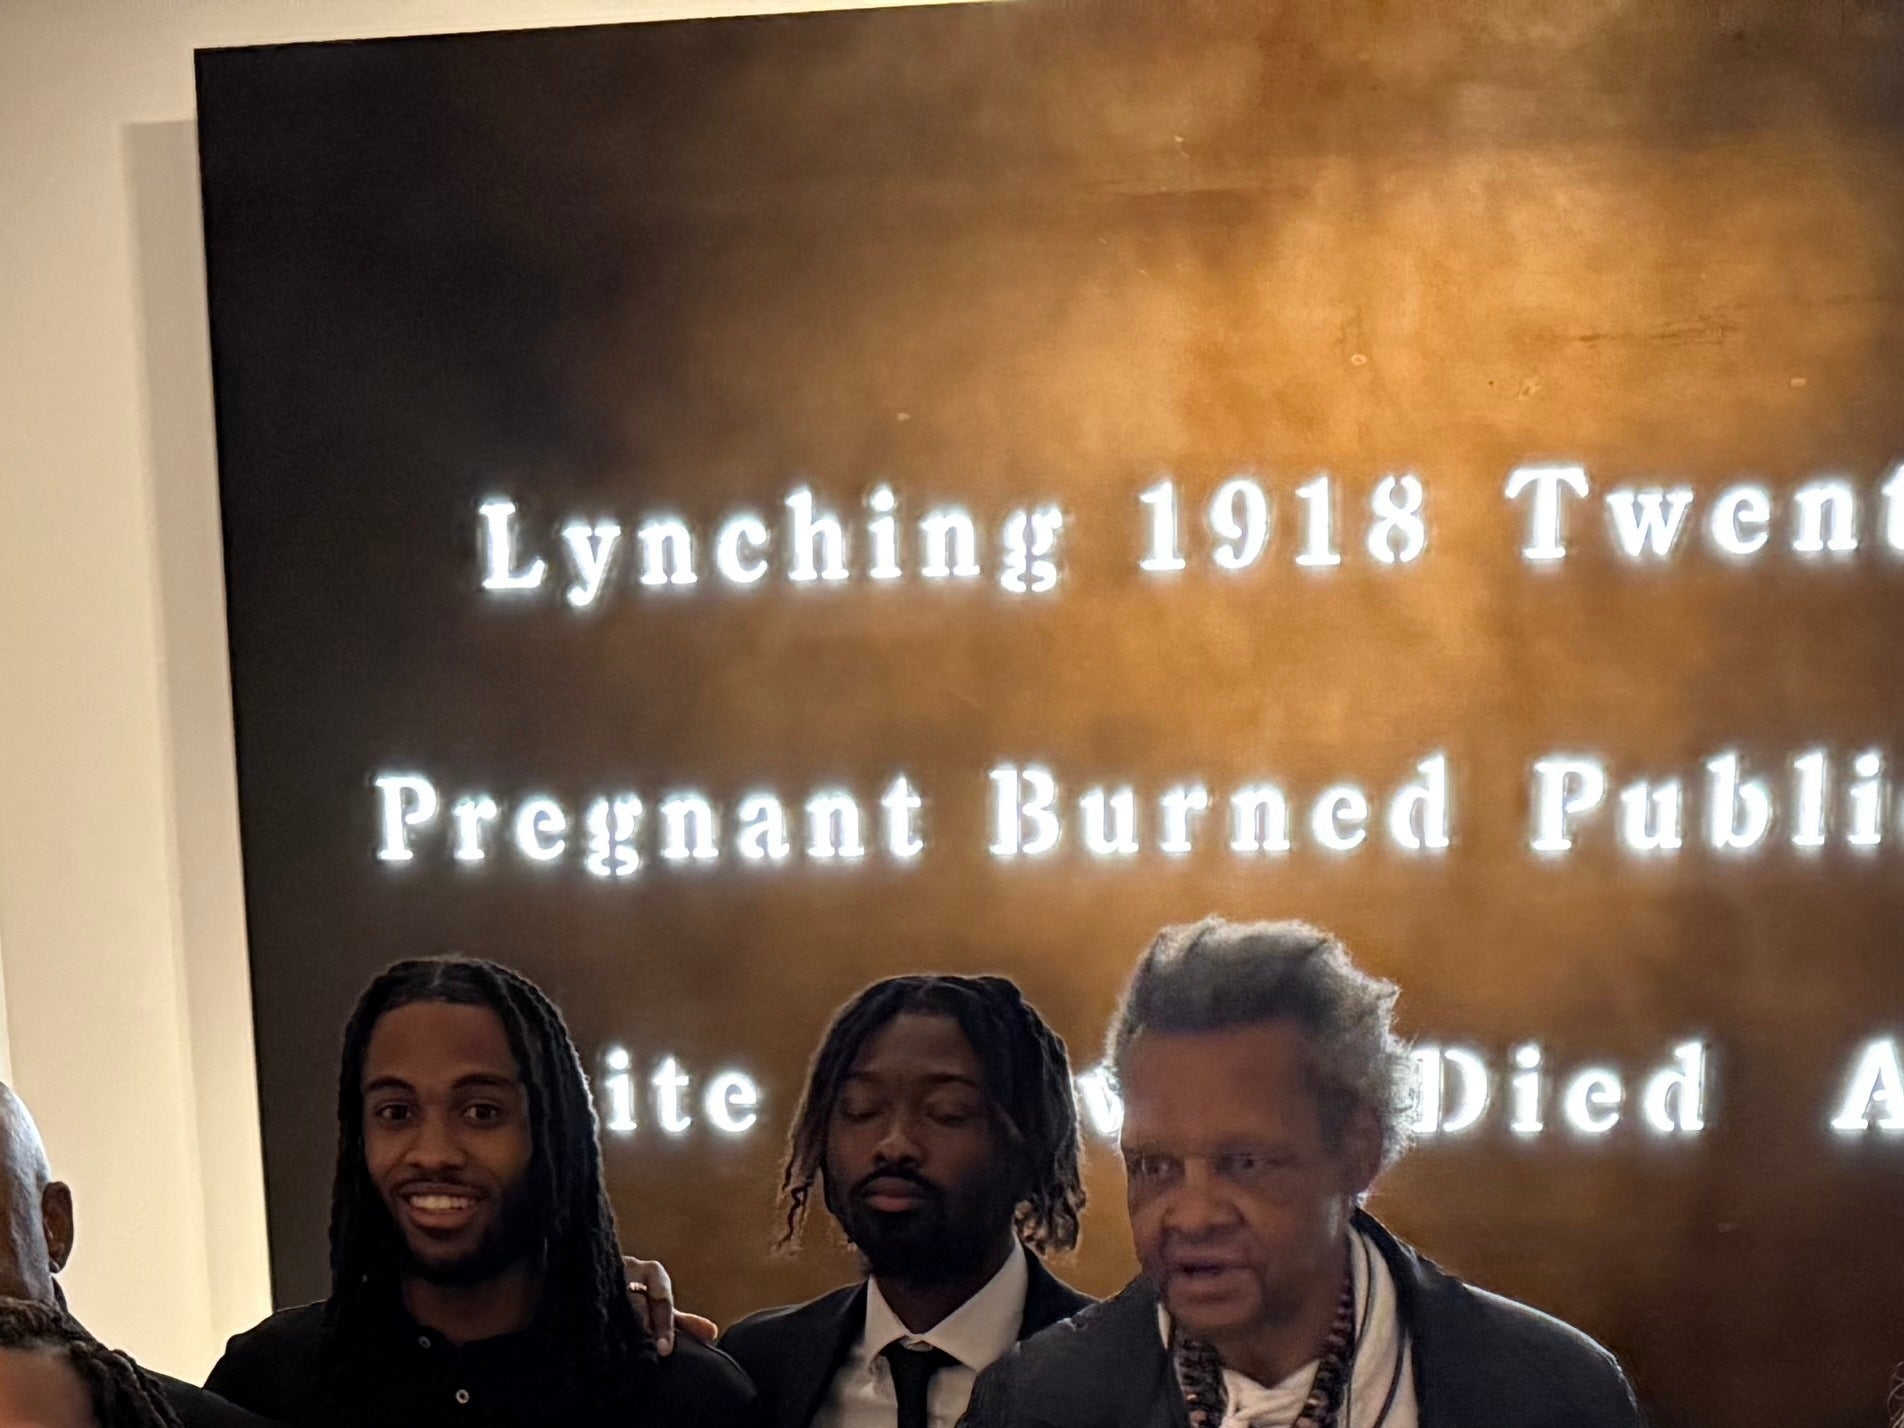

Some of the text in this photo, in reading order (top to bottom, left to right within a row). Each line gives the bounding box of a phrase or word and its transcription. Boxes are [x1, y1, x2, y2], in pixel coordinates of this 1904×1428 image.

[478, 484, 1064, 604] Lynching
[1137, 475, 1428, 571] 1918
[374, 774, 924, 876] Pregnant
[990, 754, 1451, 856] Burned
[605, 1048, 757, 1132] ite
[1416, 1040, 1705, 1135] Died
